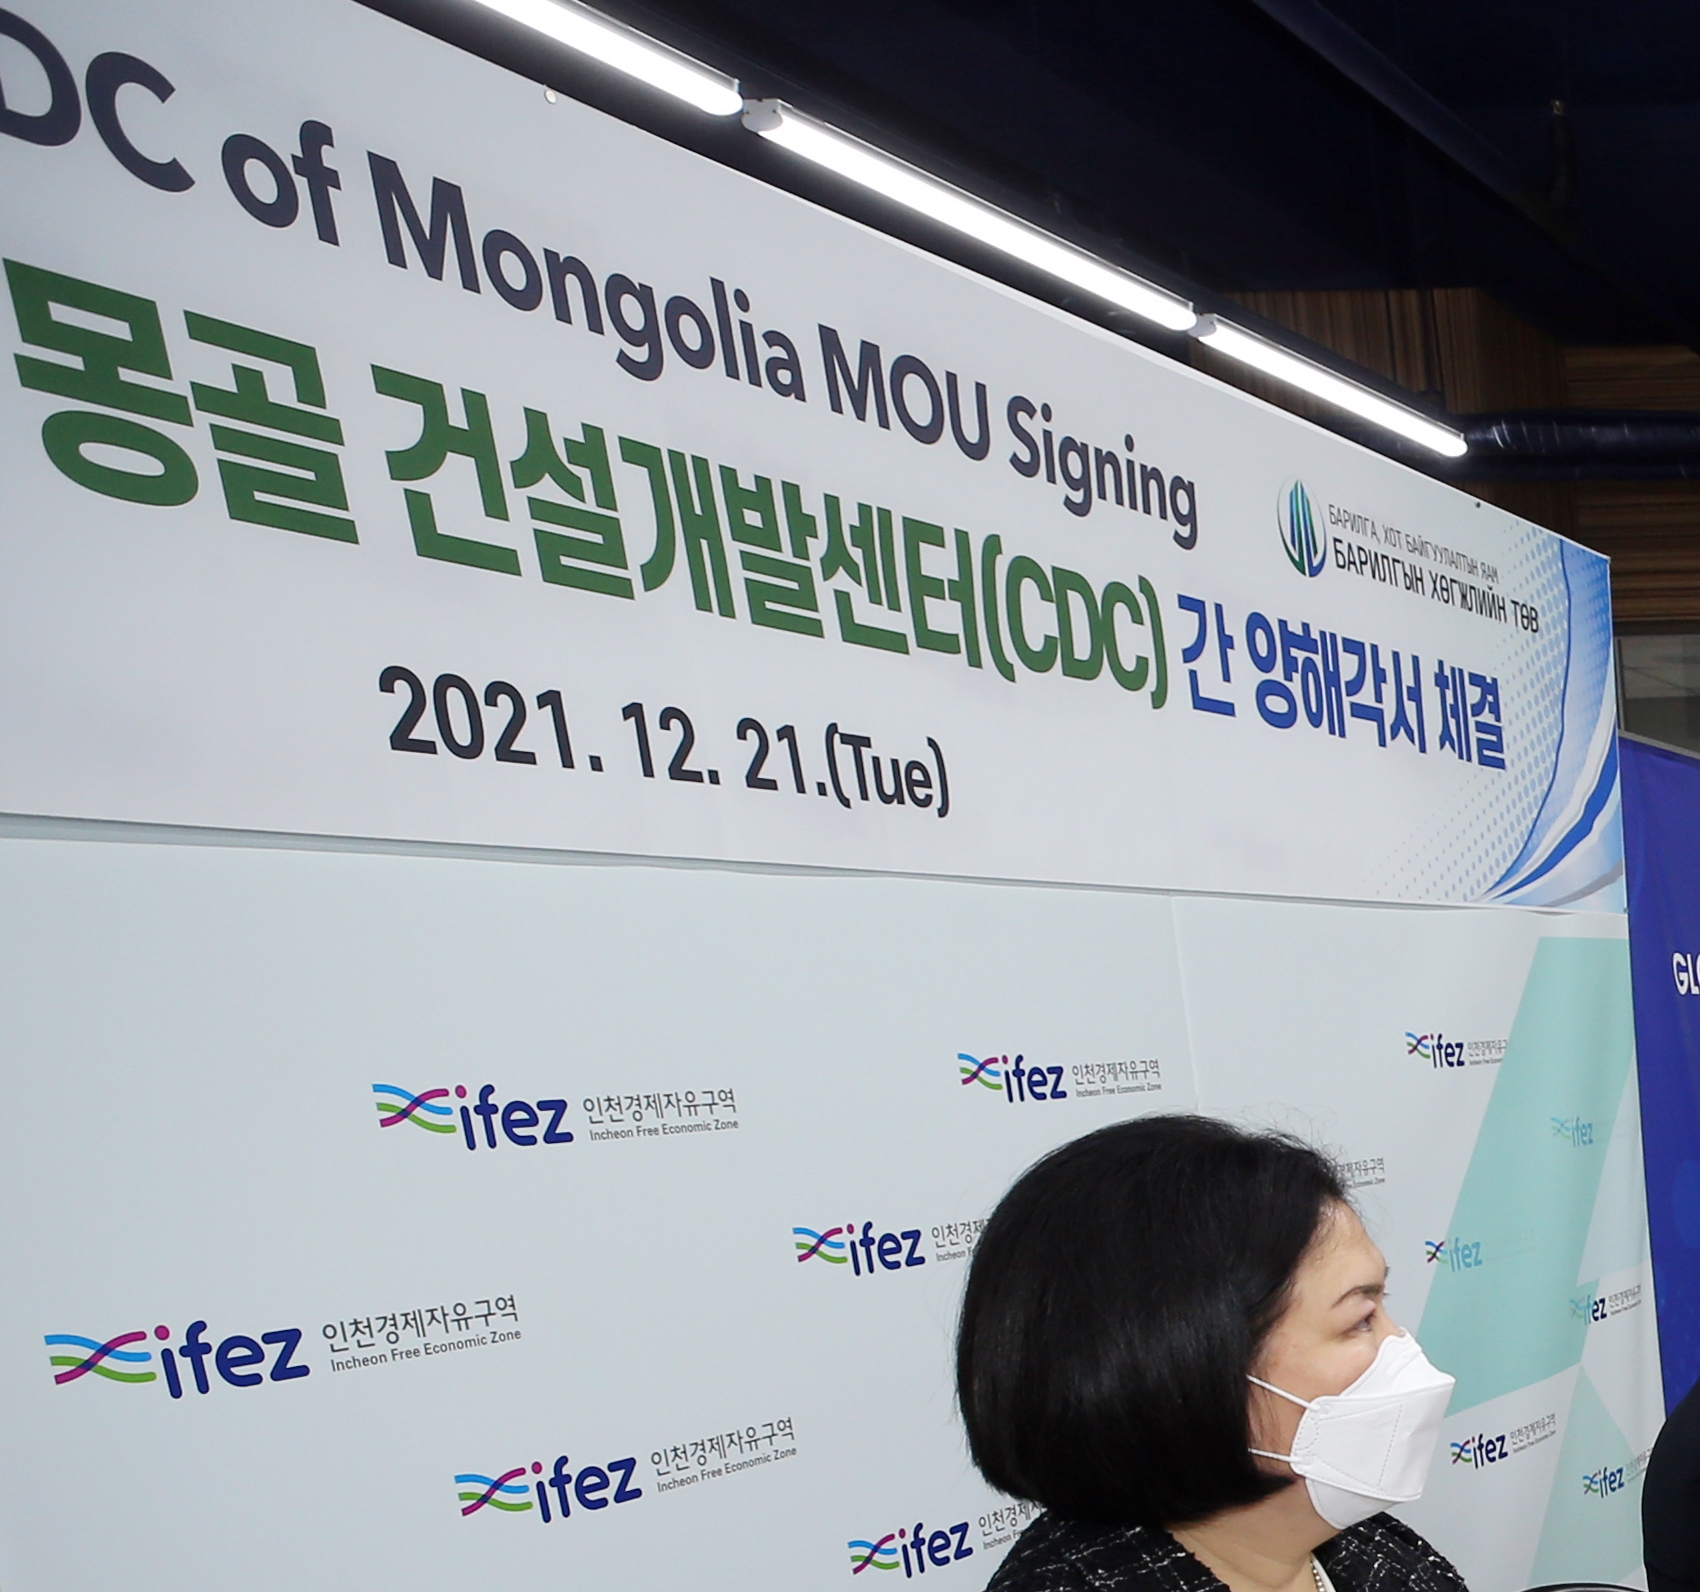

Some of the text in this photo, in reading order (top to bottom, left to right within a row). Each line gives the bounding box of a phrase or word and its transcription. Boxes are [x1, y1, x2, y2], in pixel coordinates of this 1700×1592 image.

[221, 120, 342, 246] of
[367, 150, 806, 402] Mongolia
[818, 324, 991, 460] MOU
[1007, 395, 1198, 550] Signing
[3, 257, 1506, 770] 몽골 건설개발센터(CDC) 간 양해각서 체결
[1328, 504, 1381, 544] БАРИЛГА,
[1382, 524, 1402, 550] ХОТ
[1332, 537, 1540, 634] БАРИЛГЫН ХӨГЖЛИЙН ТӨВ
[379, 665, 950, 819] 2021. 12. 21.(Tue)
[1002, 1054, 1067, 1104] ifez
[1430, 1033, 1465, 1069] ifez
[455, 1084, 574, 1151] ifez
[583, 1088, 738, 1125] 인천경제자유구역
[589, 1118, 739, 1142] Incheon Free Economic Zone
[847, 1221, 926, 1277] ifez
[322, 1294, 519, 1354] 인천경제자유구역
[330, 1328, 522, 1373] Incheon Free Economic Zone
[154, 1320, 310, 1400] ifez
[651, 1416, 796, 1477] 인천경제자유구역
[656, 1447, 797, 1493] Incheon Free Economic Zone
[1472, 1433, 1508, 1470] ifez
[531, 1455, 643, 1524] ifez
[898, 1522, 973, 1578] ifez
